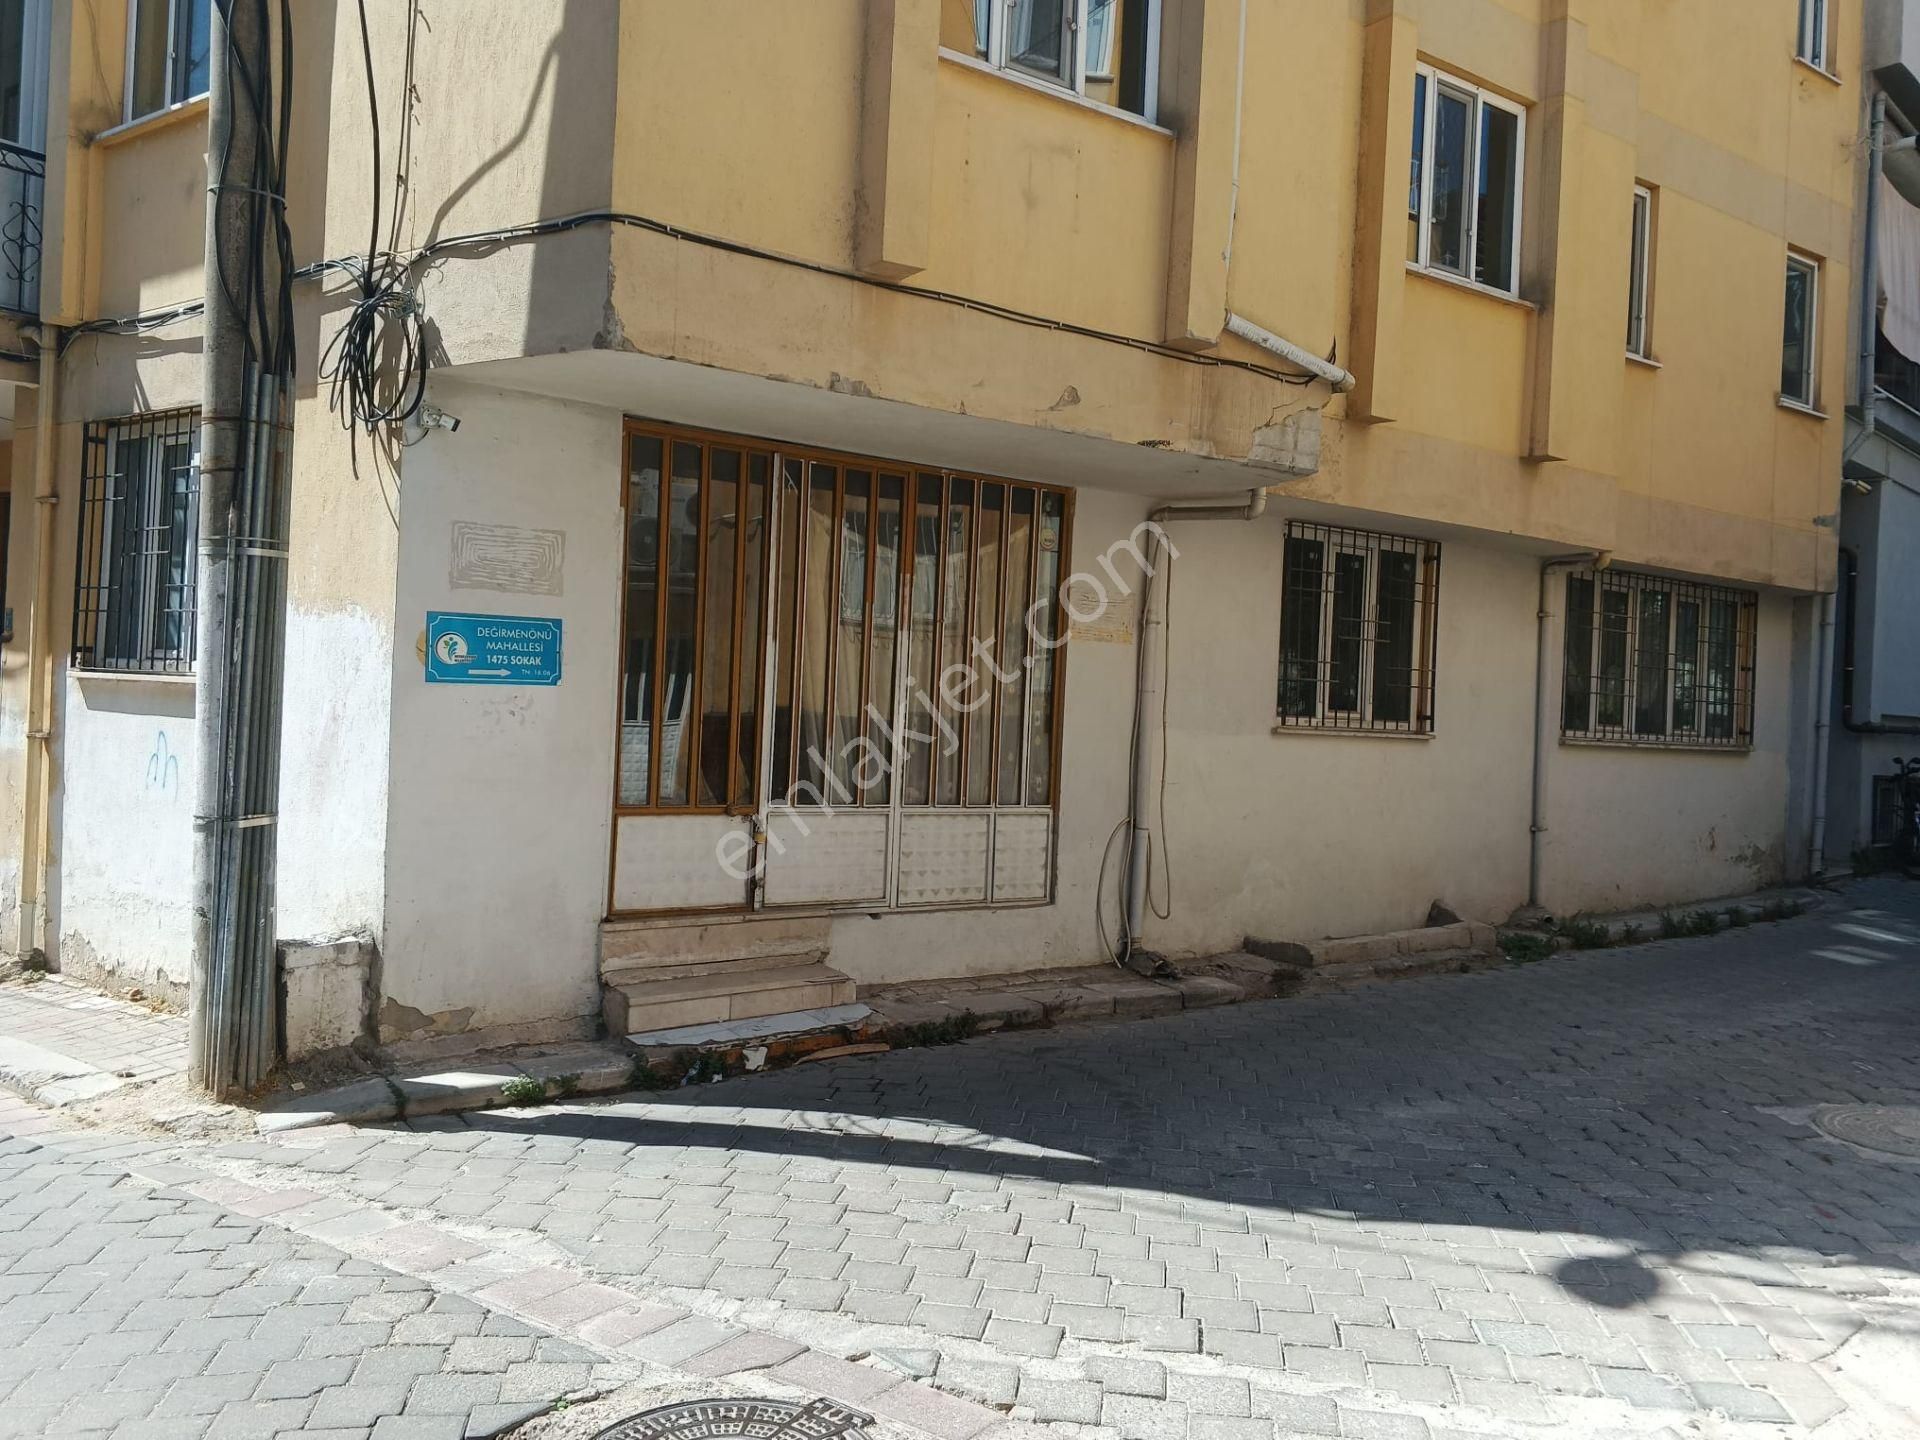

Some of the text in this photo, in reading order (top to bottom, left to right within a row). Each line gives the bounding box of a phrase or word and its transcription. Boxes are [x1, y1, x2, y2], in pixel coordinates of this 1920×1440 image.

[486, 641, 544, 652] MAHALLESİ
[487, 654, 508, 664] 1475
[510, 655, 542, 666] SOKAK
